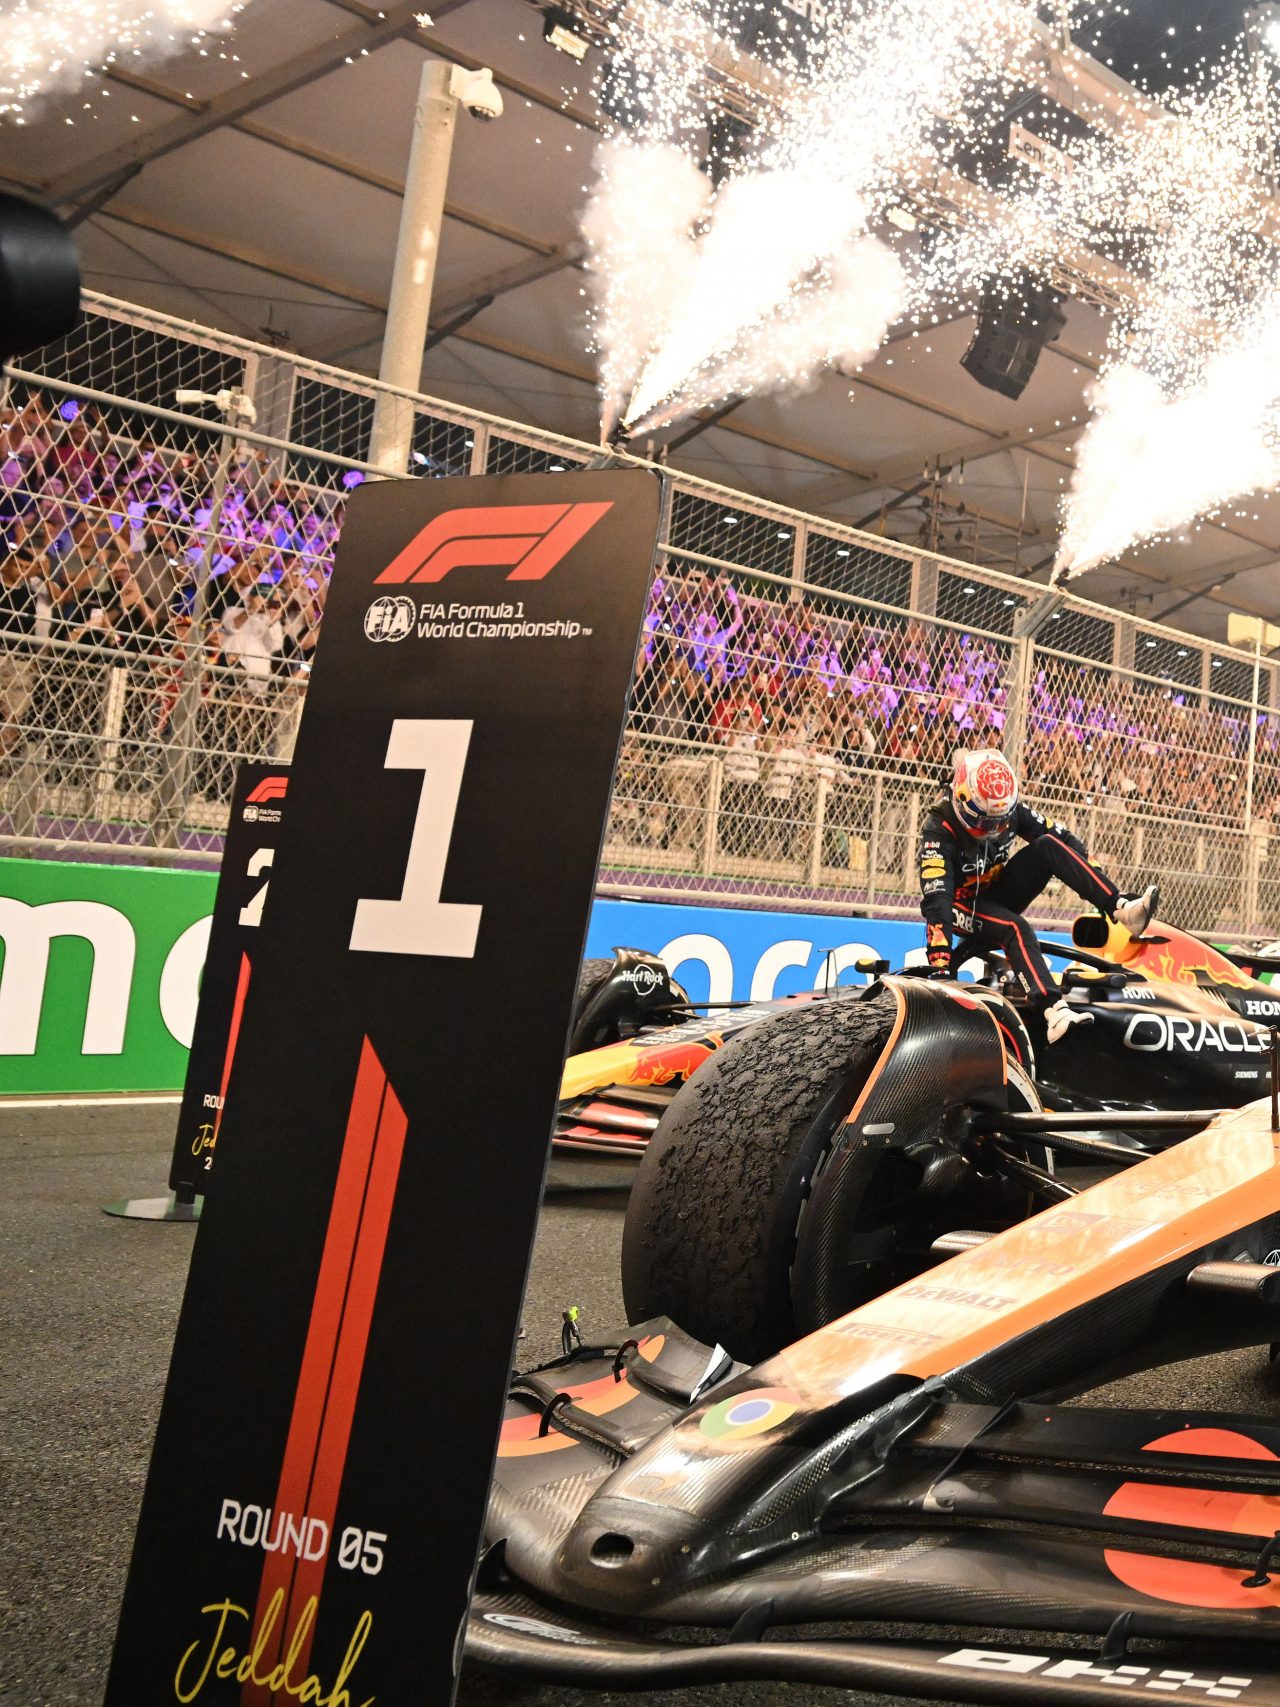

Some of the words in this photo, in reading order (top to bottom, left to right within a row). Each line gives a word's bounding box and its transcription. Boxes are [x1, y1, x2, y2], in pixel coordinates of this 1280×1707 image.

[419, 603, 446, 620] FIA
[447, 603, 514, 620] Formula
[514, 602, 525, 619] 1
[417, 621, 464, 639] World
[348, 718, 484, 959] 1
[643, 970, 664, 986] Rock
[1123, 1013, 1273, 1053] ORACLE
[834, 1322, 944, 1347] PIRELLI
[216, 1498, 329, 1563] ROUND
[338, 1525, 389, 1577] 05
[174, 1587, 376, 1707] Jeddah
